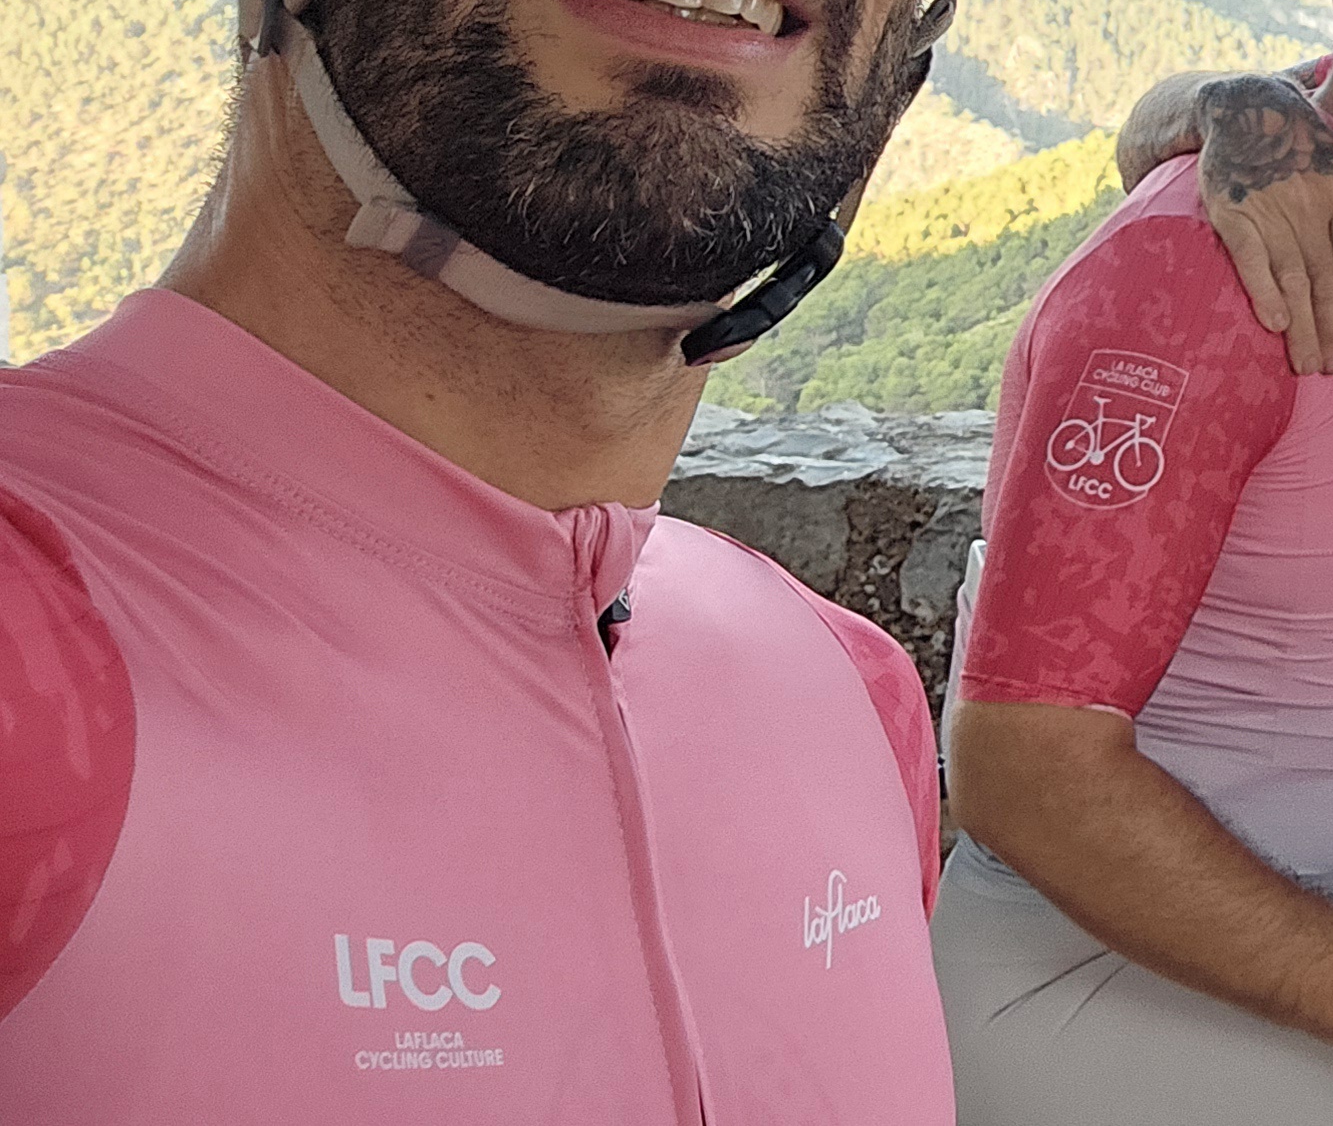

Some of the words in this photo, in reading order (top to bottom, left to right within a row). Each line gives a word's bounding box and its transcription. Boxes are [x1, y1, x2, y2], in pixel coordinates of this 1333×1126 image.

[1068, 473, 1113, 499] LFCC
[334, 934, 502, 1011] LFCC
[394, 1031, 464, 1049] LAFLACA
[354, 1049, 433, 1071] CYCLING
[435, 1048, 505, 1069] CULTURE
